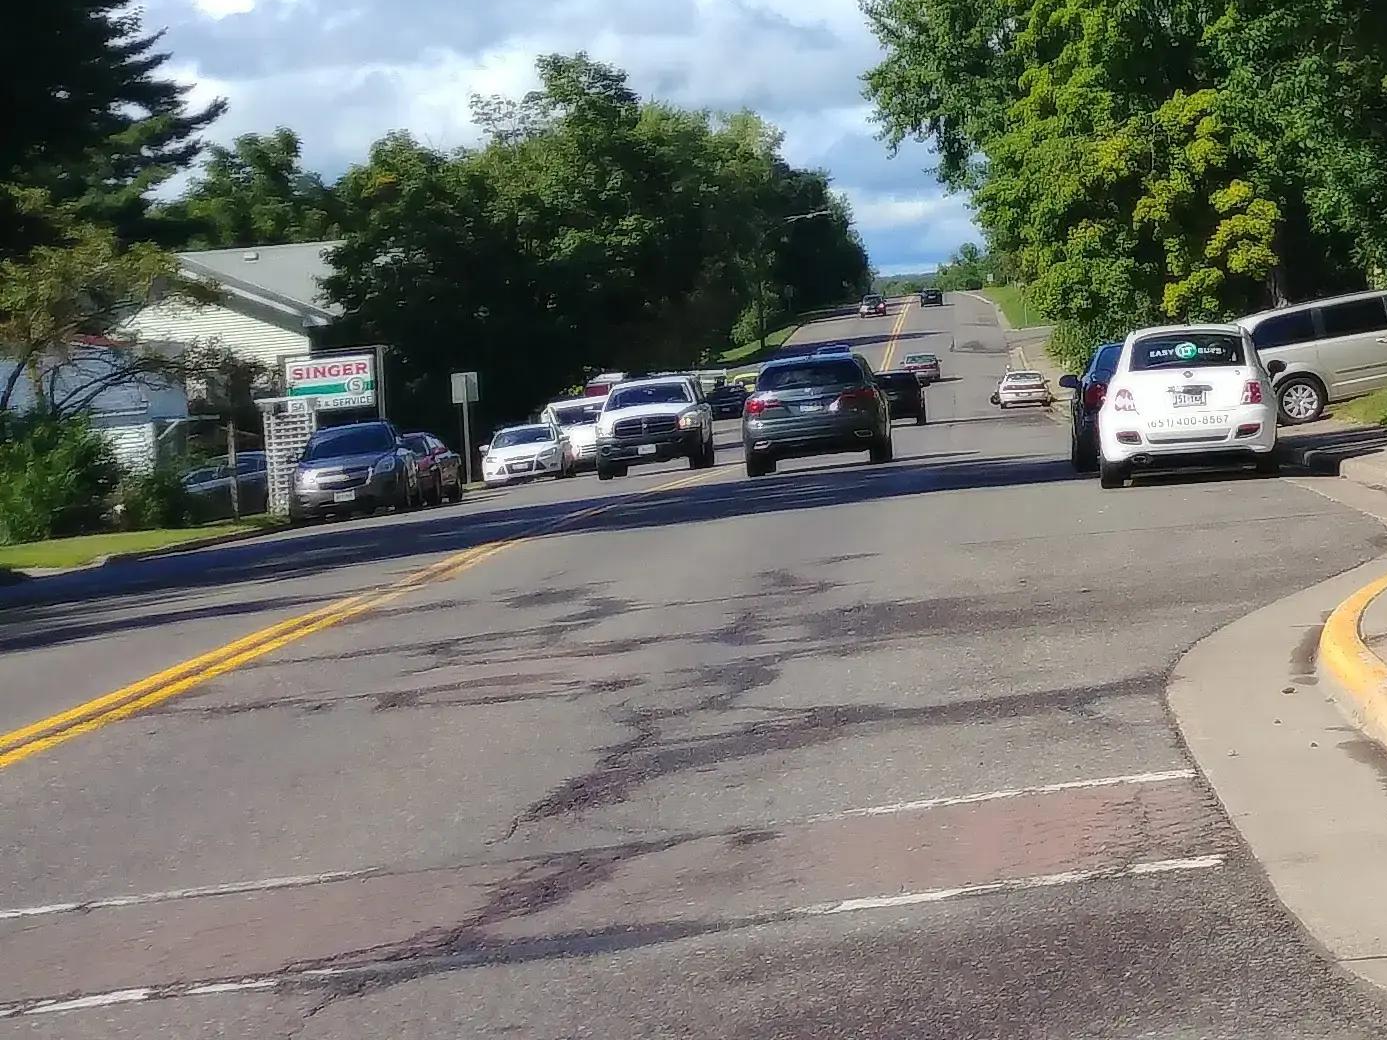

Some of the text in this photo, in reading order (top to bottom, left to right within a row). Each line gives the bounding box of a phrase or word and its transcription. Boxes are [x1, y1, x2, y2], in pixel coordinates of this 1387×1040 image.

[1149, 349, 1174, 357] EASY
[292, 363, 368, 380] SINGER
[333, 395, 372, 407] SERVICE
